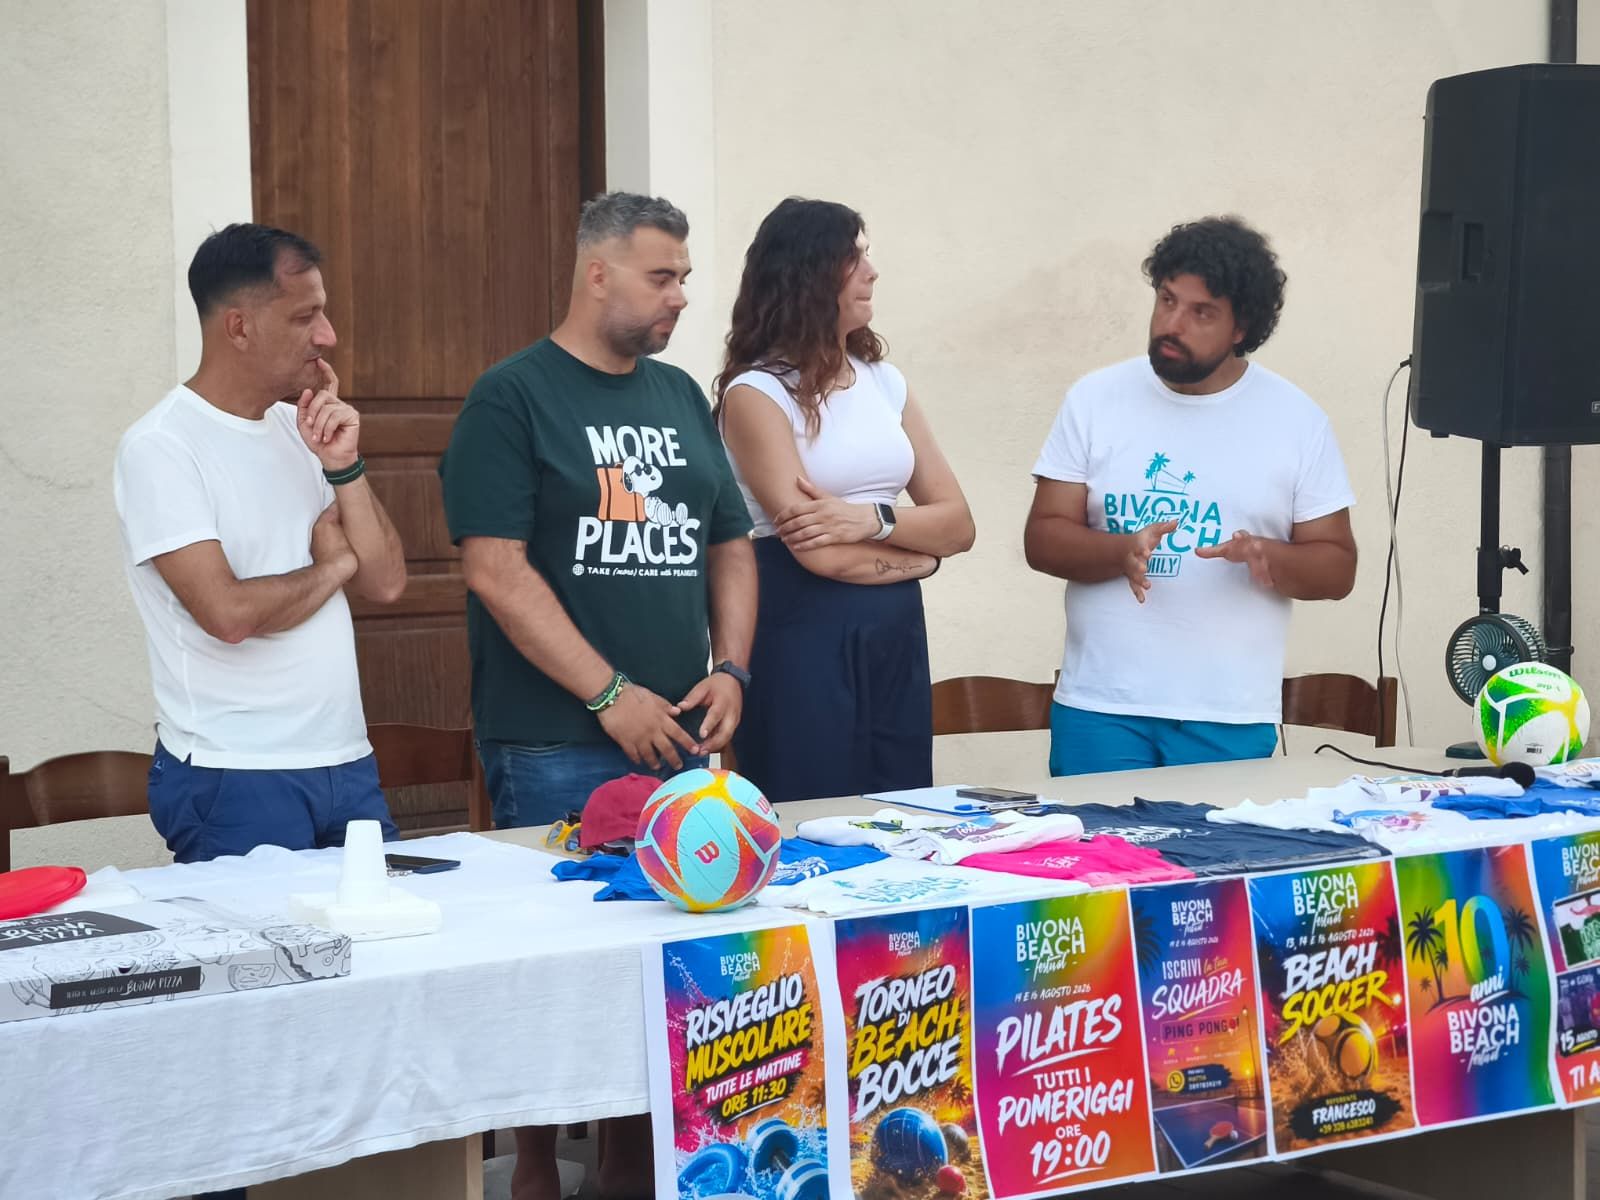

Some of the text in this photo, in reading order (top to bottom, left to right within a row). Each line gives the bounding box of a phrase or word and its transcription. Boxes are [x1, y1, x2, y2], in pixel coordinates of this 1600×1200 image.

[585, 425, 687, 467] MORE
[1104, 493, 1222, 526] BIVONA
[575, 516, 701, 564] PLACES
[1106, 517, 1222, 553] BECH
[587, 567, 610, 575] TAKE
[1561, 842, 1600, 861] BIVON
[1563, 856, 1600, 876] BEAC
[1292, 872, 1357, 896] BIVONA
[1171, 898, 1212, 913] BIVONA
[1294, 888, 1359, 916] BEACH
[1016, 916, 1084, 942] BIVONA
[1172, 910, 1213, 926] BEACH
[889, 930, 920, 942] BIVONA
[889, 939, 921, 952] BEACH
[1016, 933, 1086, 963] BEACH
[1310, 934, 1316, 945] E
[1327, 929, 1358, 942] AGOSTO
[1434, 895, 1511, 988] 10
[720, 951, 759, 966] BIVONA
[721, 961, 760, 976] BEACH
[1162, 958, 1201, 980] ISCRIVI
[1280, 942, 1378, 999] BEACH
[855, 964, 955, 1028] TORNEO
[1023, 991, 1030, 1002] E
[1040, 985, 1071, 1001] AGOSTO
[1152, 968, 1247, 1019] SQUADRA
[1470, 965, 1505, 1002] anni
[686, 973, 803, 1048] RISVEGLIO
[898, 1012, 910, 1028] DI
[1279, 970, 1394, 1045] SOCCER
[1447, 1003, 1519, 1031] BIVONA
[850, 1000, 961, 1079] BEACH
[995, 993, 1123, 1077] PILATES
[1164, 1023, 1193, 1039] PING
[1450, 1022, 1520, 1054] BEACH
[1560, 1029, 1575, 1053] 15
[686, 1003, 812, 1092] MUSCOLARE
[705, 1052, 803, 1104] TUTTE LE MATTINE
[851, 1035, 960, 1122] BOCCE
[1033, 1066, 1091, 1091] TUTTI I
[1569, 1064, 1585, 1091] TI
[722, 1078, 787, 1117] ORE 11:30
[998, 1078, 1134, 1136] POMERIGGI
[1312, 1098, 1377, 1125] FRANCESCO
[1055, 1124, 1081, 1139] ORE
[1029, 1129, 1111, 1178] 19:00
